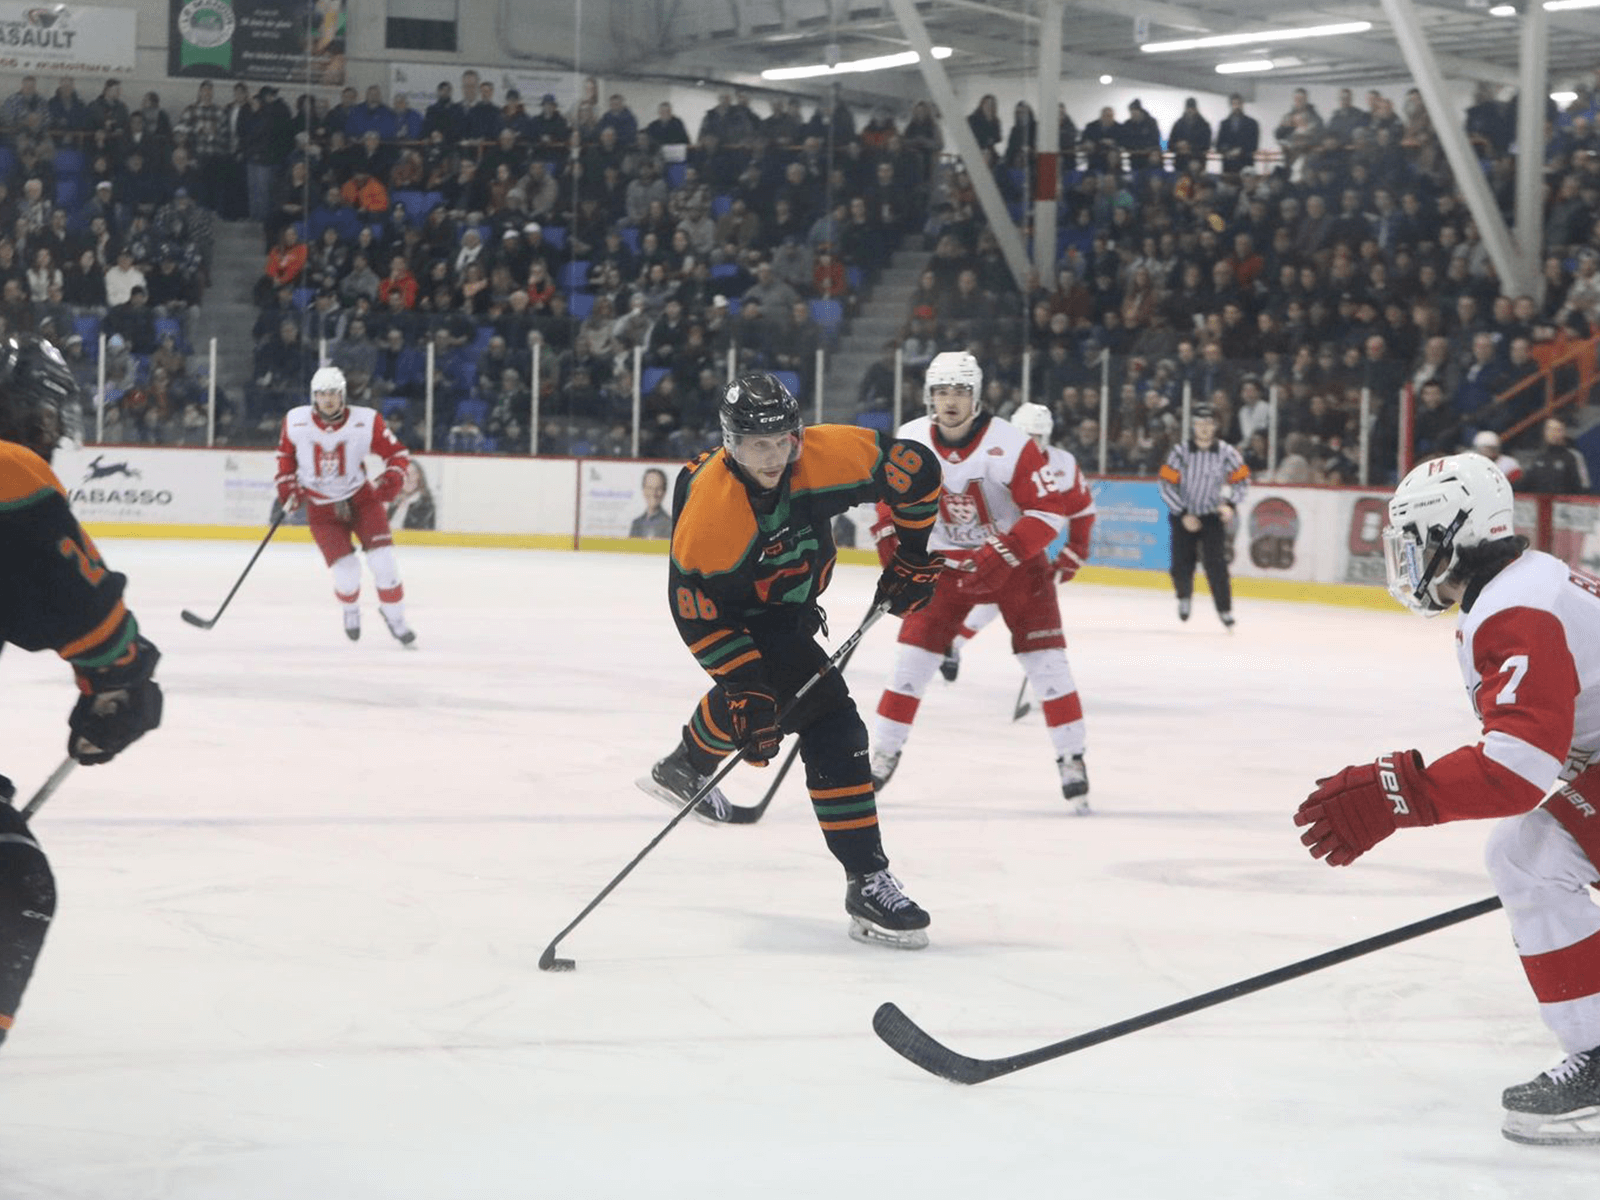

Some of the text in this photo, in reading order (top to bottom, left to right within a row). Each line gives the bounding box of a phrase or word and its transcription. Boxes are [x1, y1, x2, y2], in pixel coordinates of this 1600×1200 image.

[760, 414, 785, 424] CCM
[884, 442, 923, 494] 86
[1428, 459, 1445, 477] M
[67, 488, 173, 506] ABASSO
[676, 586, 718, 620] 86
[1495, 654, 1529, 705] 7
